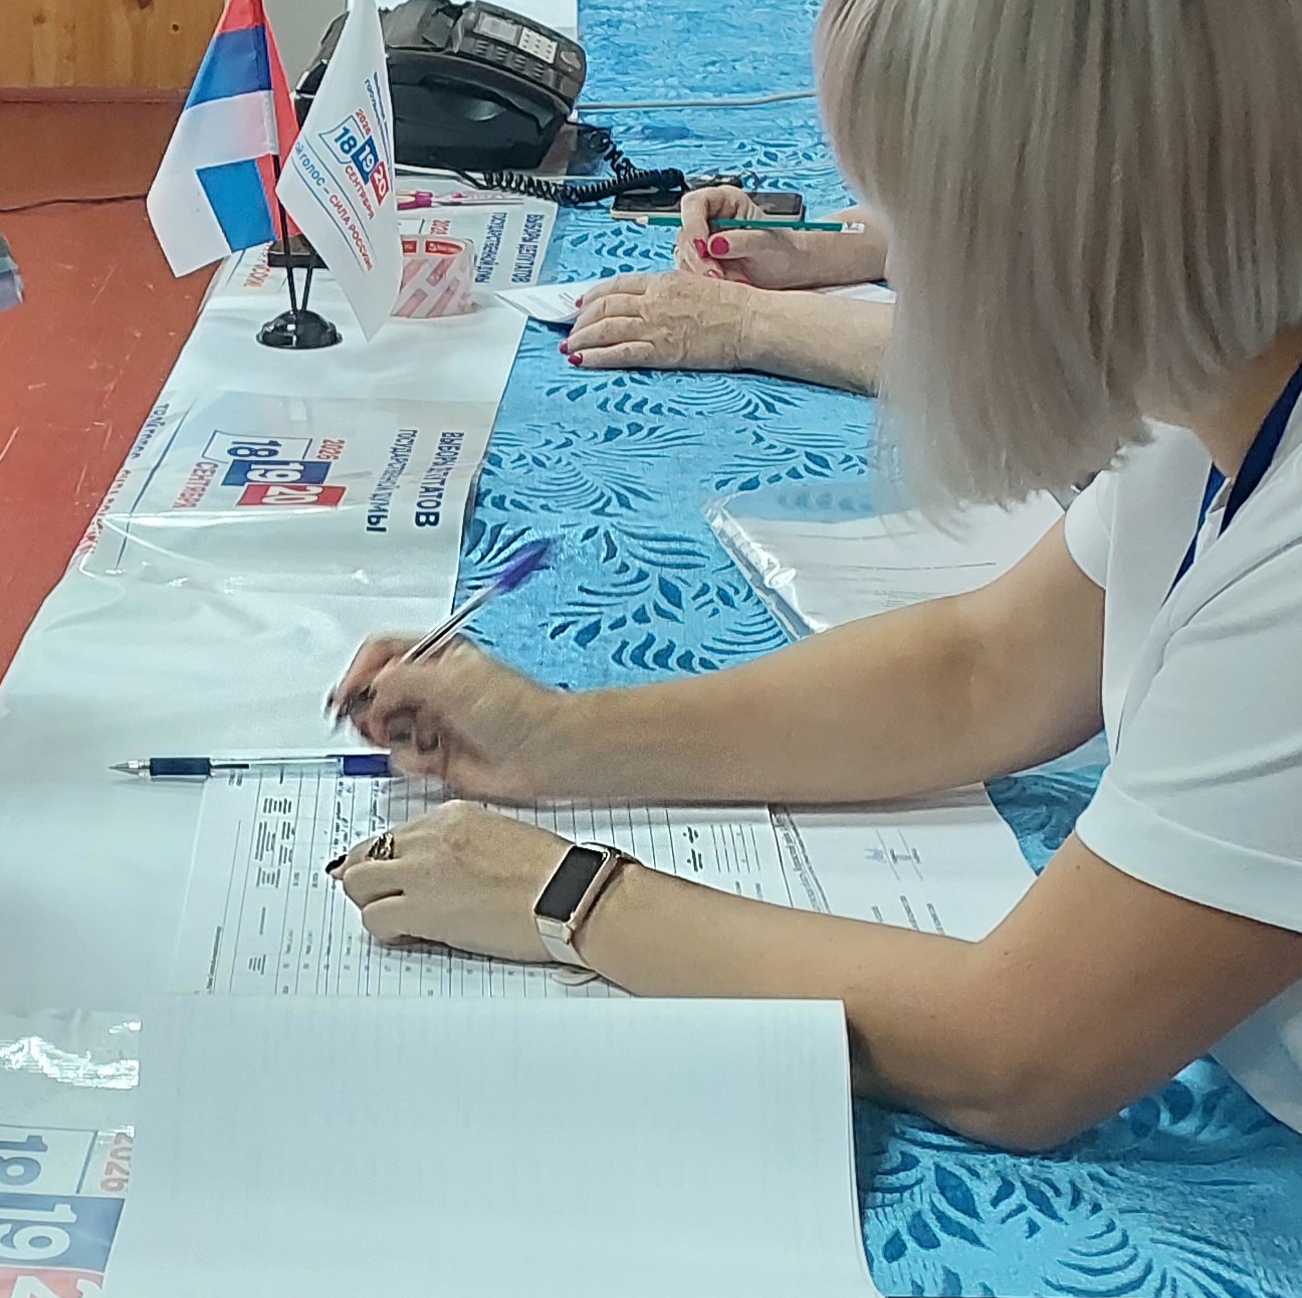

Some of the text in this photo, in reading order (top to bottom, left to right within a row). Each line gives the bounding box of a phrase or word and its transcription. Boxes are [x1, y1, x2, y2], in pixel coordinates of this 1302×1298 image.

[299, 151, 326, 187] ГОЛОС
[329, 194, 352, 226] СИЛА
[333, 125, 357, 155] 18
[357, 144, 375, 173] 19
[371, 167, 388, 197] 20
[226, 439, 324, 504] 18 19 20
